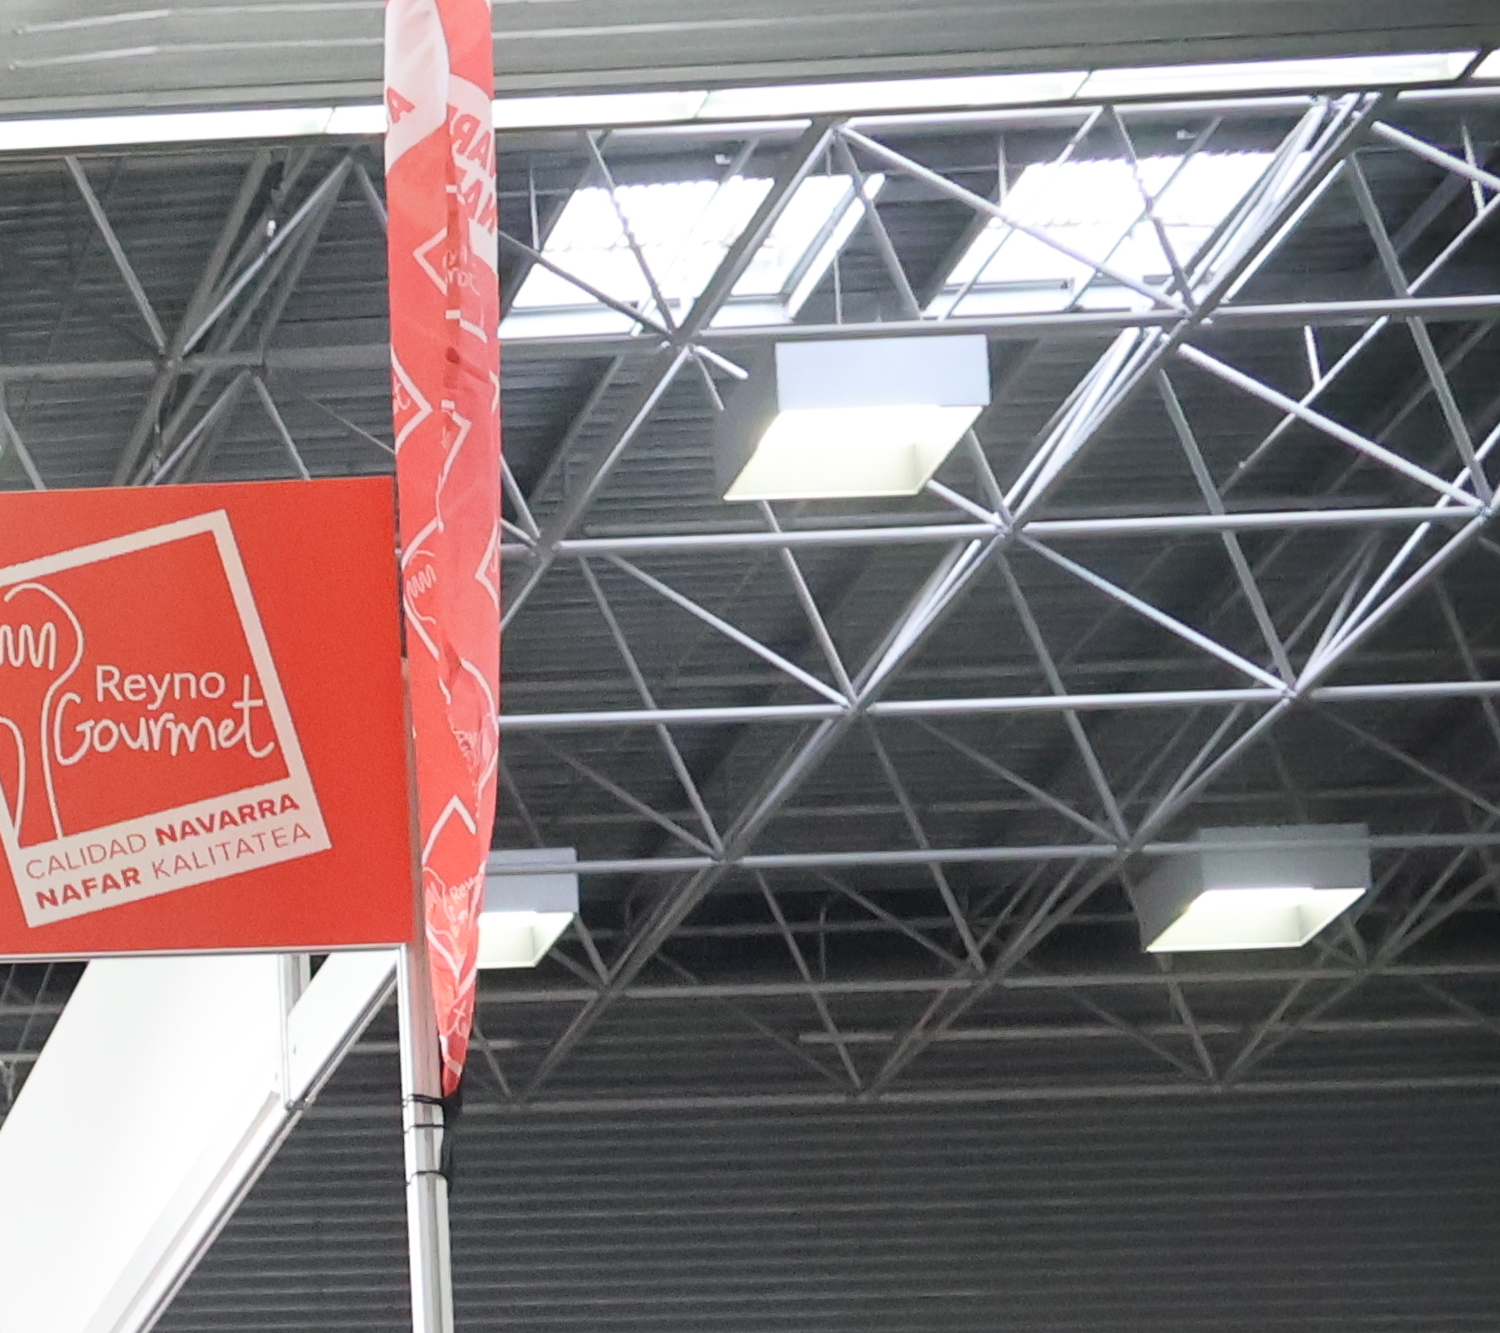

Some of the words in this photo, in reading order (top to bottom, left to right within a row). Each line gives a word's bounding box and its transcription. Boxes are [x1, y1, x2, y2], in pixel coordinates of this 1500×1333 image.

[54, 674, 275, 766] Gourmet
[96, 665, 225, 710] Reyno
[25, 833, 147, 880] CALIDAD
[155, 793, 300, 847] NAVARRA
[35, 867, 140, 910] NAFAR
[152, 823, 312, 880] KALITATEA
